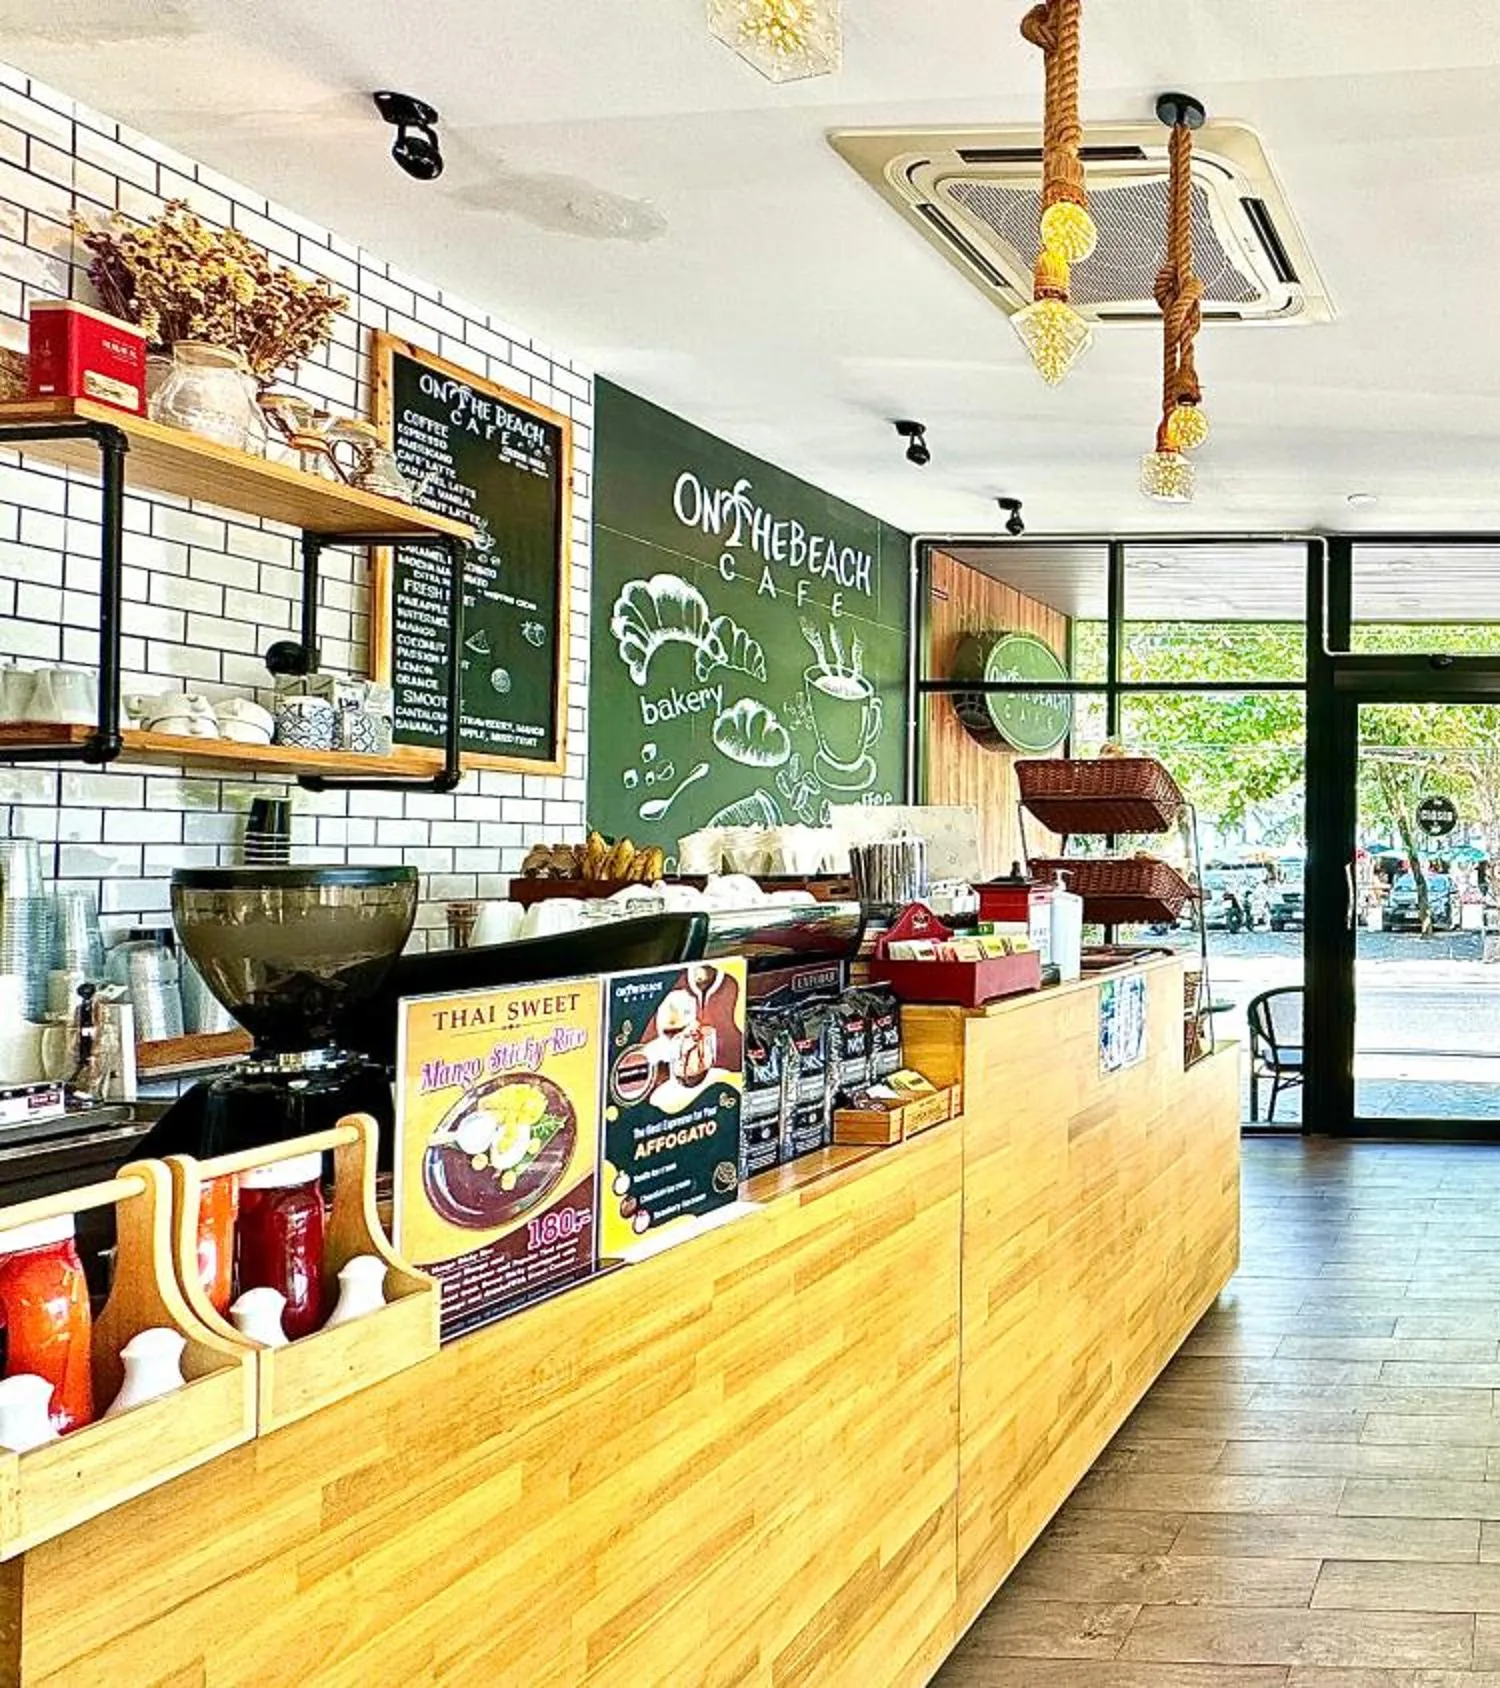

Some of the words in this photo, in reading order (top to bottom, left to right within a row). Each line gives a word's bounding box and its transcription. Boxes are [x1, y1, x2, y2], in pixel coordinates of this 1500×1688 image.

[403, 409, 449, 438] COFFEE
[451, 409, 511, 446] CAFE
[495, 404, 546, 446] BEACH
[403, 578, 443, 600] FRESH
[719, 553, 845, 618] CAFE
[396, 619, 437, 637] MANGO
[396, 634, 447, 653] COCONUT
[396, 647, 440, 663] PASSION
[396, 660, 434, 675] LEMON
[396, 674, 439, 690] ORANGE
[639, 683, 724, 727] bakery
[432, 1004, 496, 1031] THAI
[507, 993, 581, 1021] SWEET
[420, 1056, 484, 1092] Mango
[489, 1036, 548, 1073] Sticky
[549, 1026, 588, 1055] Rice
[634, 1120, 717, 1160] AFFOGATO
